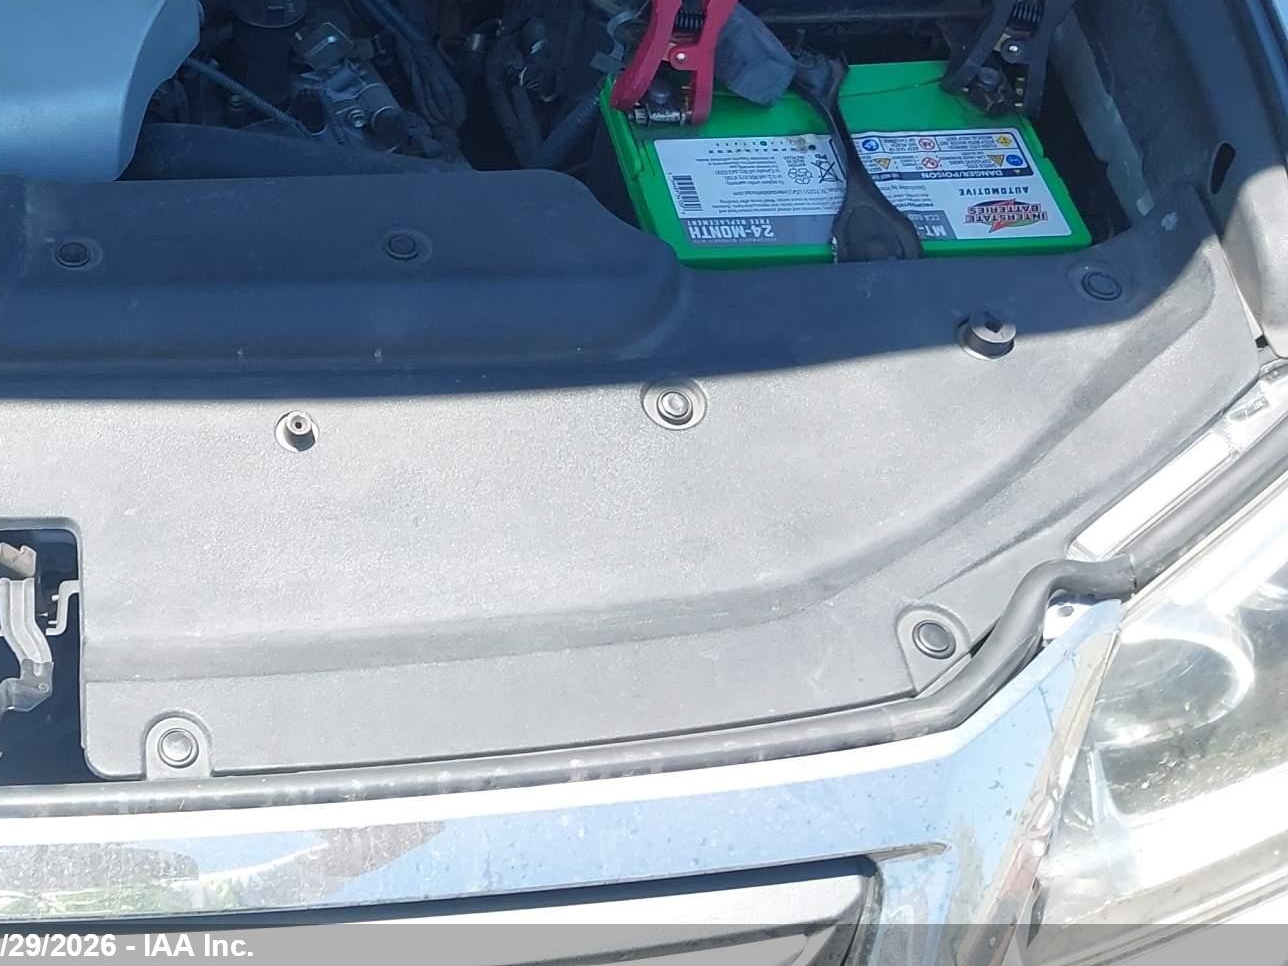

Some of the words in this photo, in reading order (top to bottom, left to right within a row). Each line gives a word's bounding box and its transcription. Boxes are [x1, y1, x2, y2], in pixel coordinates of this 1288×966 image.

[921, 169, 1004, 179] DANGER/POISON
[959, 186, 1029, 196] AUTOMOTIVE
[968, 203, 1041, 215] BATTERIES
[966, 211, 1047, 223] INTERSTATE
[689, 225, 774, 239] 24-MONTH
[916, 224, 946, 236] MT-
